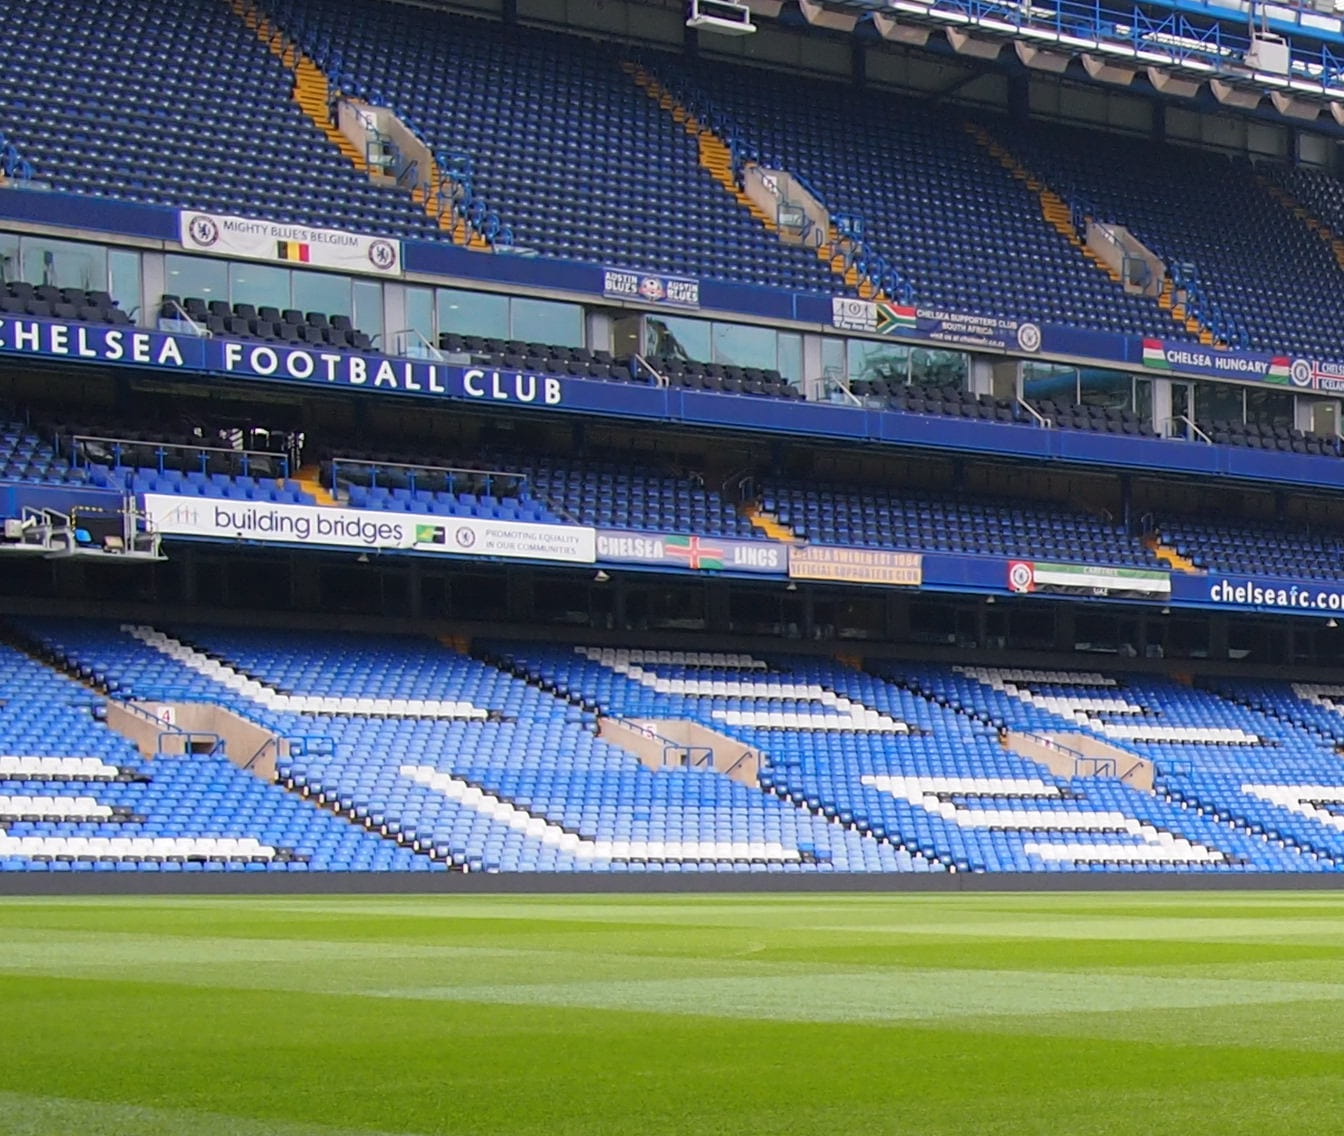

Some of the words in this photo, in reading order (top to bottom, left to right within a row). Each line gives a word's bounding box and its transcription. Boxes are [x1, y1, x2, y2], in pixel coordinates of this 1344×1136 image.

[223, 220, 269, 238] MIGHTY
[271, 225, 308, 241] BLUE'S
[310, 230, 359, 247] BELGIUM
[605, 279, 638, 293] BLUES
[606, 271, 638, 284] AUSTIN
[667, 288, 698, 302] BLUES
[916, 309, 950, 321] CHELSEA
[951, 312, 997, 327] SUPPORTERS
[998, 319, 1018, 330] CLUB
[942, 321, 966, 331] SOUTH
[968, 325, 994, 335] AFRICA
[0, 320, 183, 366] HELSEA
[225, 343, 445, 394] FOOTBALL
[463, 369, 561, 404] CLUB
[1167, 350, 1212, 367] CHELSEA
[1215, 356, 1269, 374] HUNGARY
[214, 506, 310, 539] building
[316, 514, 403, 544] bridges
[485, 529, 537, 542] PROMOTING
[538, 533, 580, 545] EQUALITY
[485, 541, 495, 549] IN
[496, 542, 516, 550] OUR
[516, 543, 576, 555] COMMUNITIES
[597, 536, 664, 559] CHELSEA
[734, 546, 778, 567] LINCS
